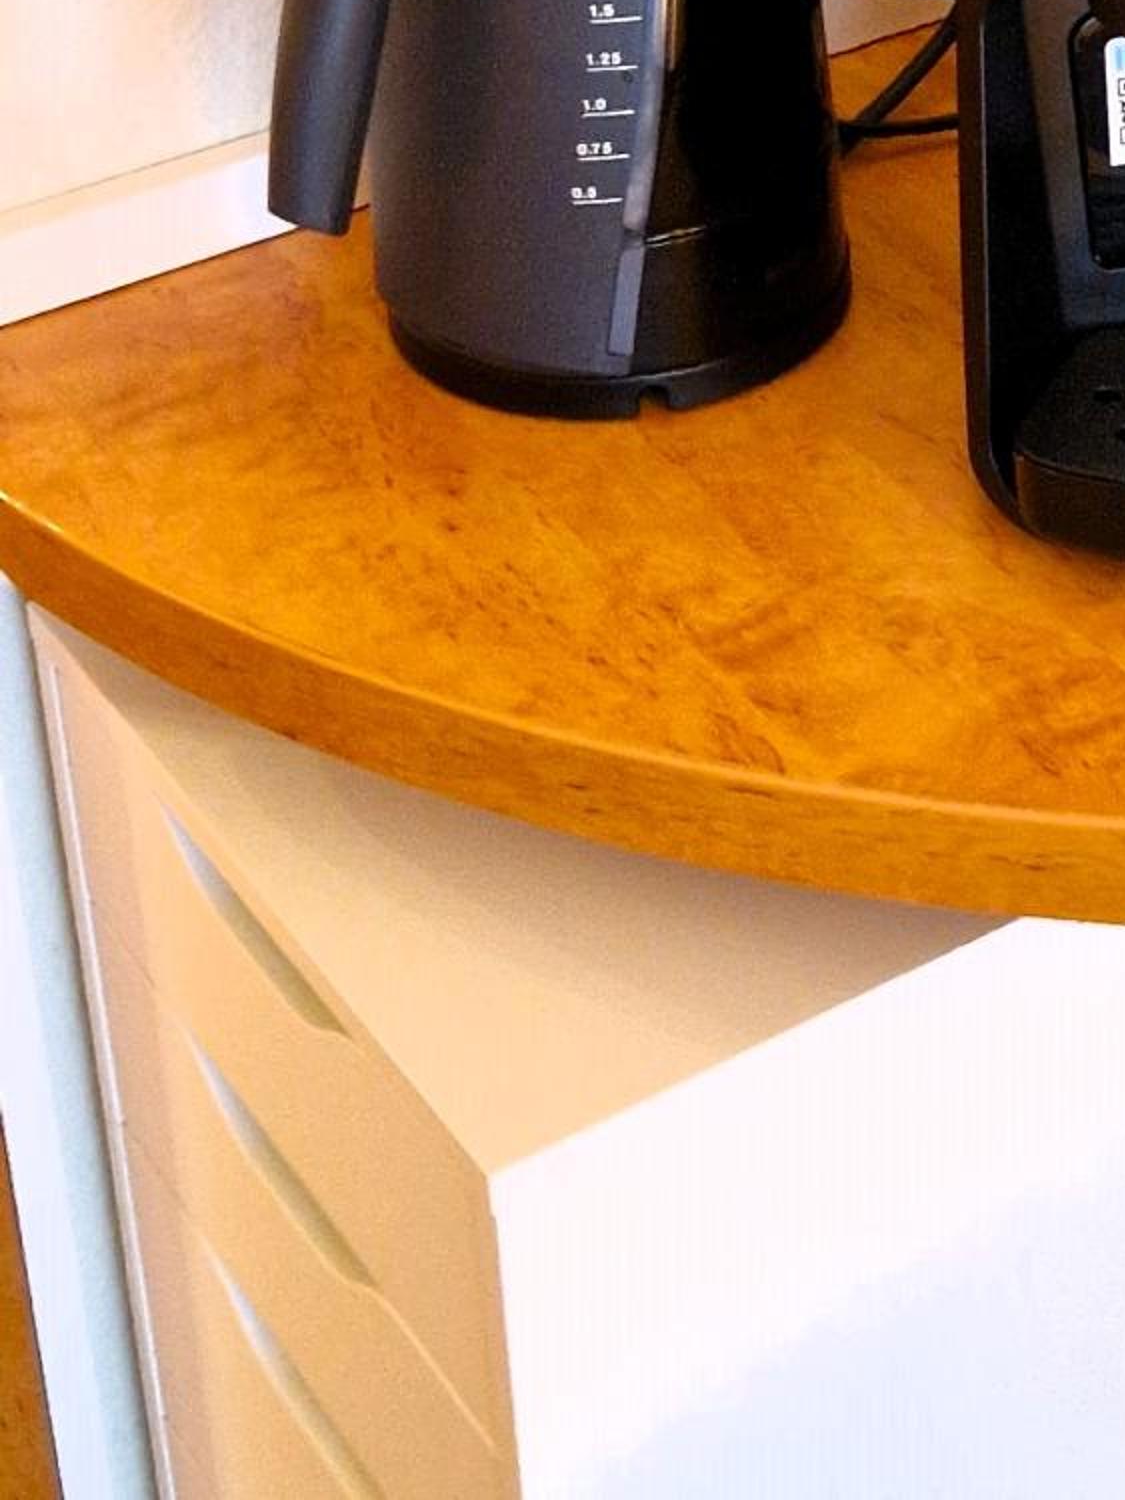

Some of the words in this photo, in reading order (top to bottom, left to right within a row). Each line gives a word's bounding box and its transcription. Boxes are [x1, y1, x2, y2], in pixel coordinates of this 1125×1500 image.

[588, 3, 615, 17] 1.5
[586, 52, 621, 66] 1.25
[582, 98, 607, 111] 1.0
[575, 142, 612, 156] 0.75
[571, 186, 597, 199] 0.5
